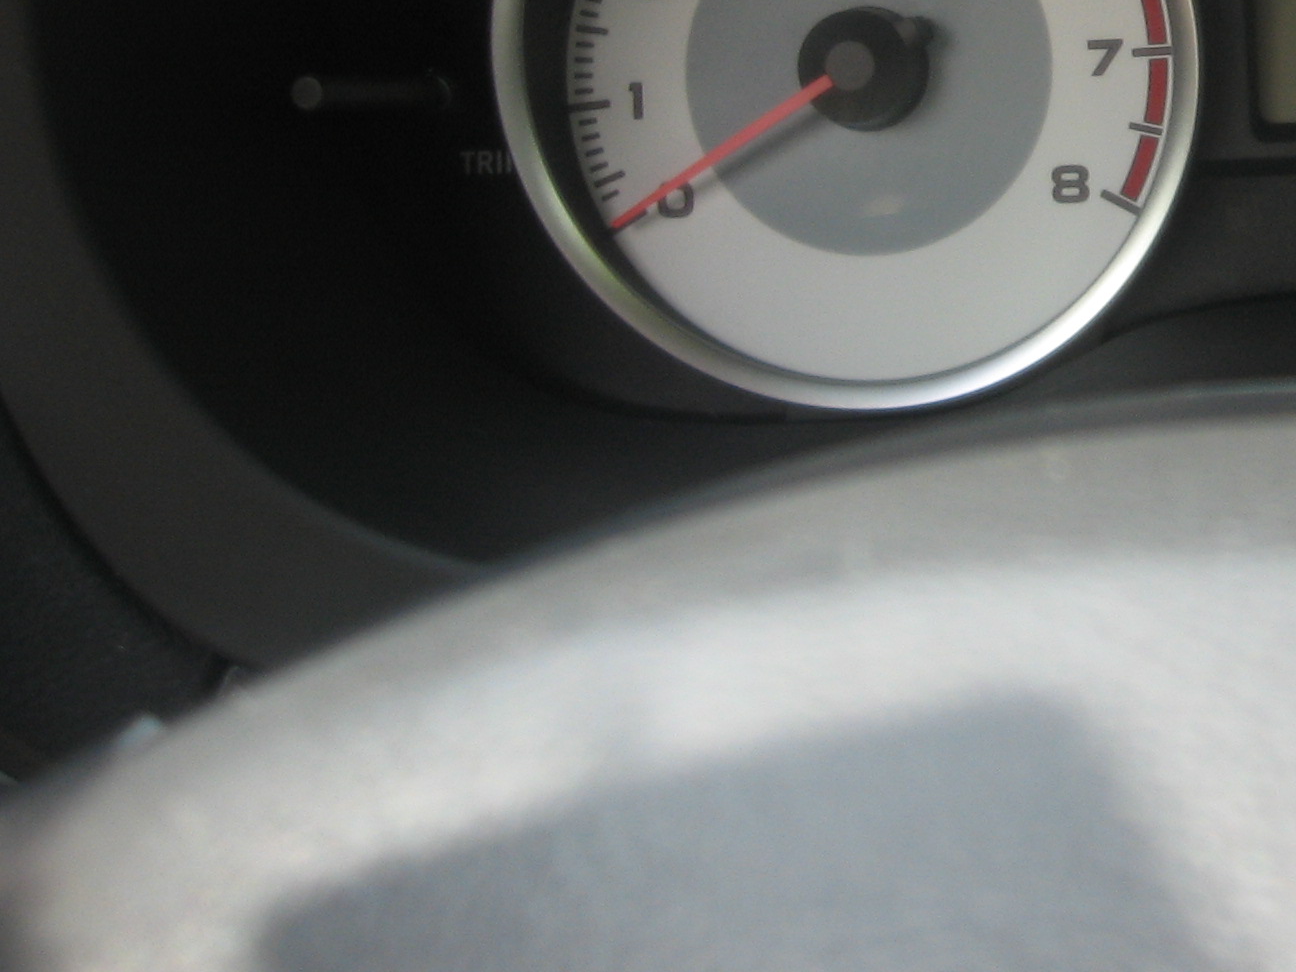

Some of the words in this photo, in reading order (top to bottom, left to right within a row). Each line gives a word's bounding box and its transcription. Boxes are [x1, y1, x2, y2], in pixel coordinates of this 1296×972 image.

[1087, 38, 1124, 76] 7
[628, 81, 644, 120] 1
[657, 180, 695, 218] 0
[1051, 164, 1090, 204] 8
